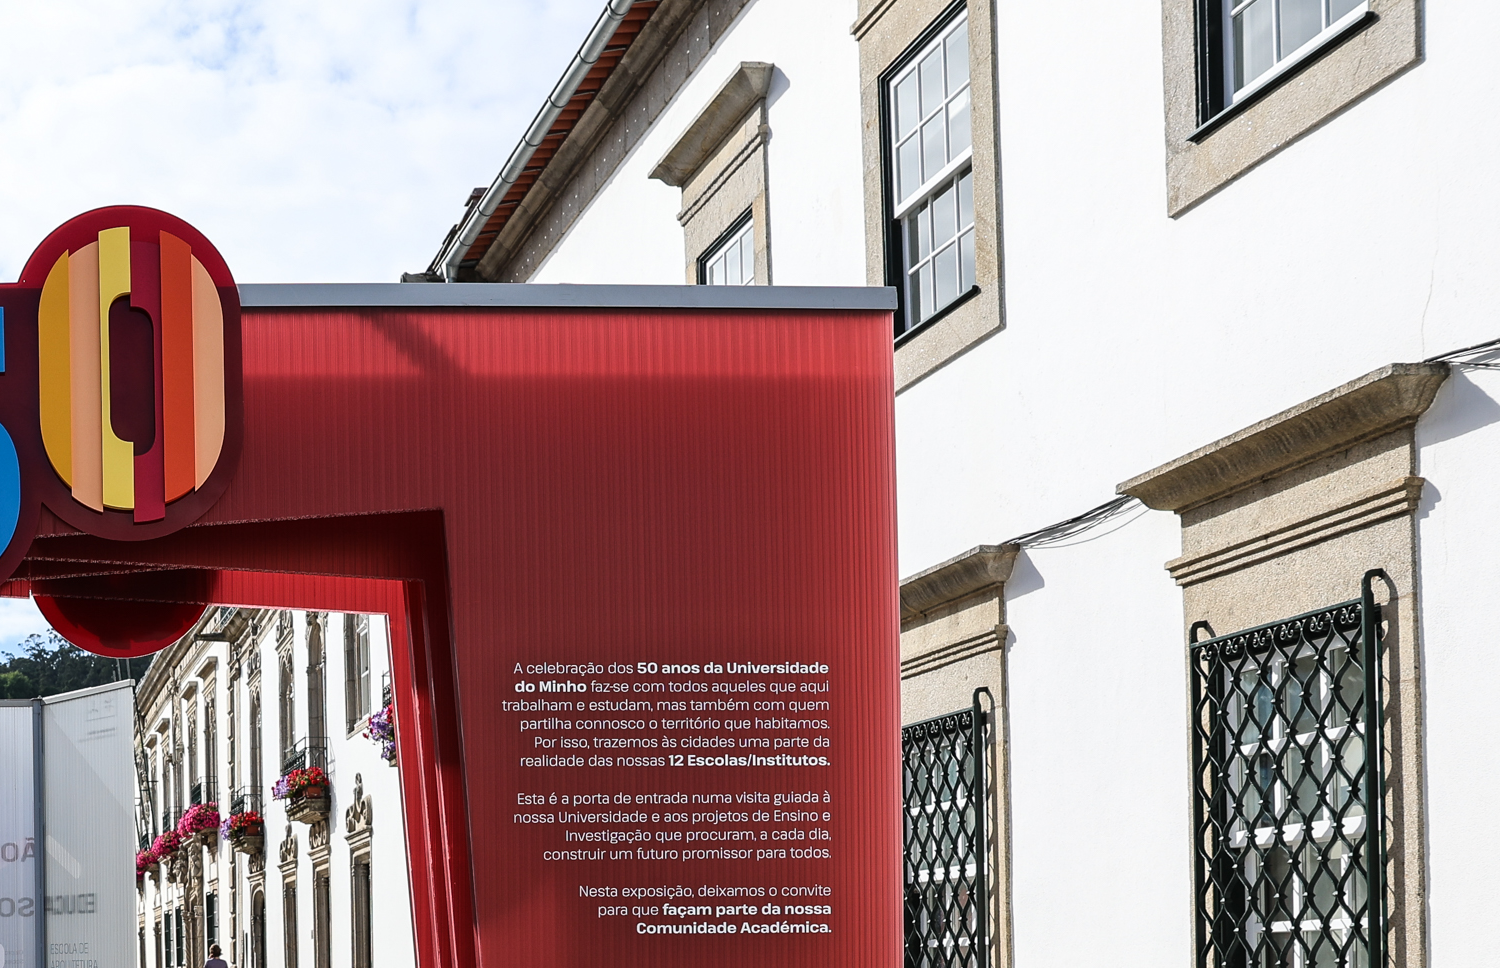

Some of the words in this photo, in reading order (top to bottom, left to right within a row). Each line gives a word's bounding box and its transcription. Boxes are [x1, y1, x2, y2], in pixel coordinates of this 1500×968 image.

[513, 662, 523, 674] A
[526, 661, 603, 676] celebração
[607, 661, 633, 674] dos
[637, 662, 657, 674] 50
[661, 664, 700, 674] anos
[703, 661, 722, 674] da
[726, 661, 829, 674] Universidade
[514, 680, 535, 692] do
[539, 679, 586, 692] Minho
[590, 680, 628, 692] faz-se
[632, 682, 664, 693] com
[668, 680, 708, 692] todos
[711, 680, 765, 694] aqueles
[769, 682, 796, 694] que
[799, 680, 828, 694] aqui
[501, 698, 572, 711] trabalham
[576, 701, 585, 711] e
[589, 698, 653, 712] estudam,
[656, 701, 686, 711] mas
[689, 698, 749, 711] também
[753, 700, 784, 711] com
[788, 701, 829, 713] quem
[520, 717, 571, 732] partilha
[575, 719, 645, 730] connosco
[649, 719, 657, 729] o
[661, 716, 720, 729] território
[724, 719, 751, 732] que
[755, 716, 830, 729] habitamos.
[534, 736, 557, 748] Por
[560, 736, 589, 749] isso,
[592, 736, 658, 748] trazemos
[661, 735, 677, 748] às
[680, 735, 735, 748] cidades
[738, 738, 769, 748] uma
[773, 736, 809, 750] parte
[813, 735, 829, 747] da
[520, 754, 584, 767] realidade
[588, 754, 613, 766] das
[617, 756, 665, 766] nossas
[668, 754, 684, 766] 12
[687, 753, 830, 766] Escolas/Institutos.
